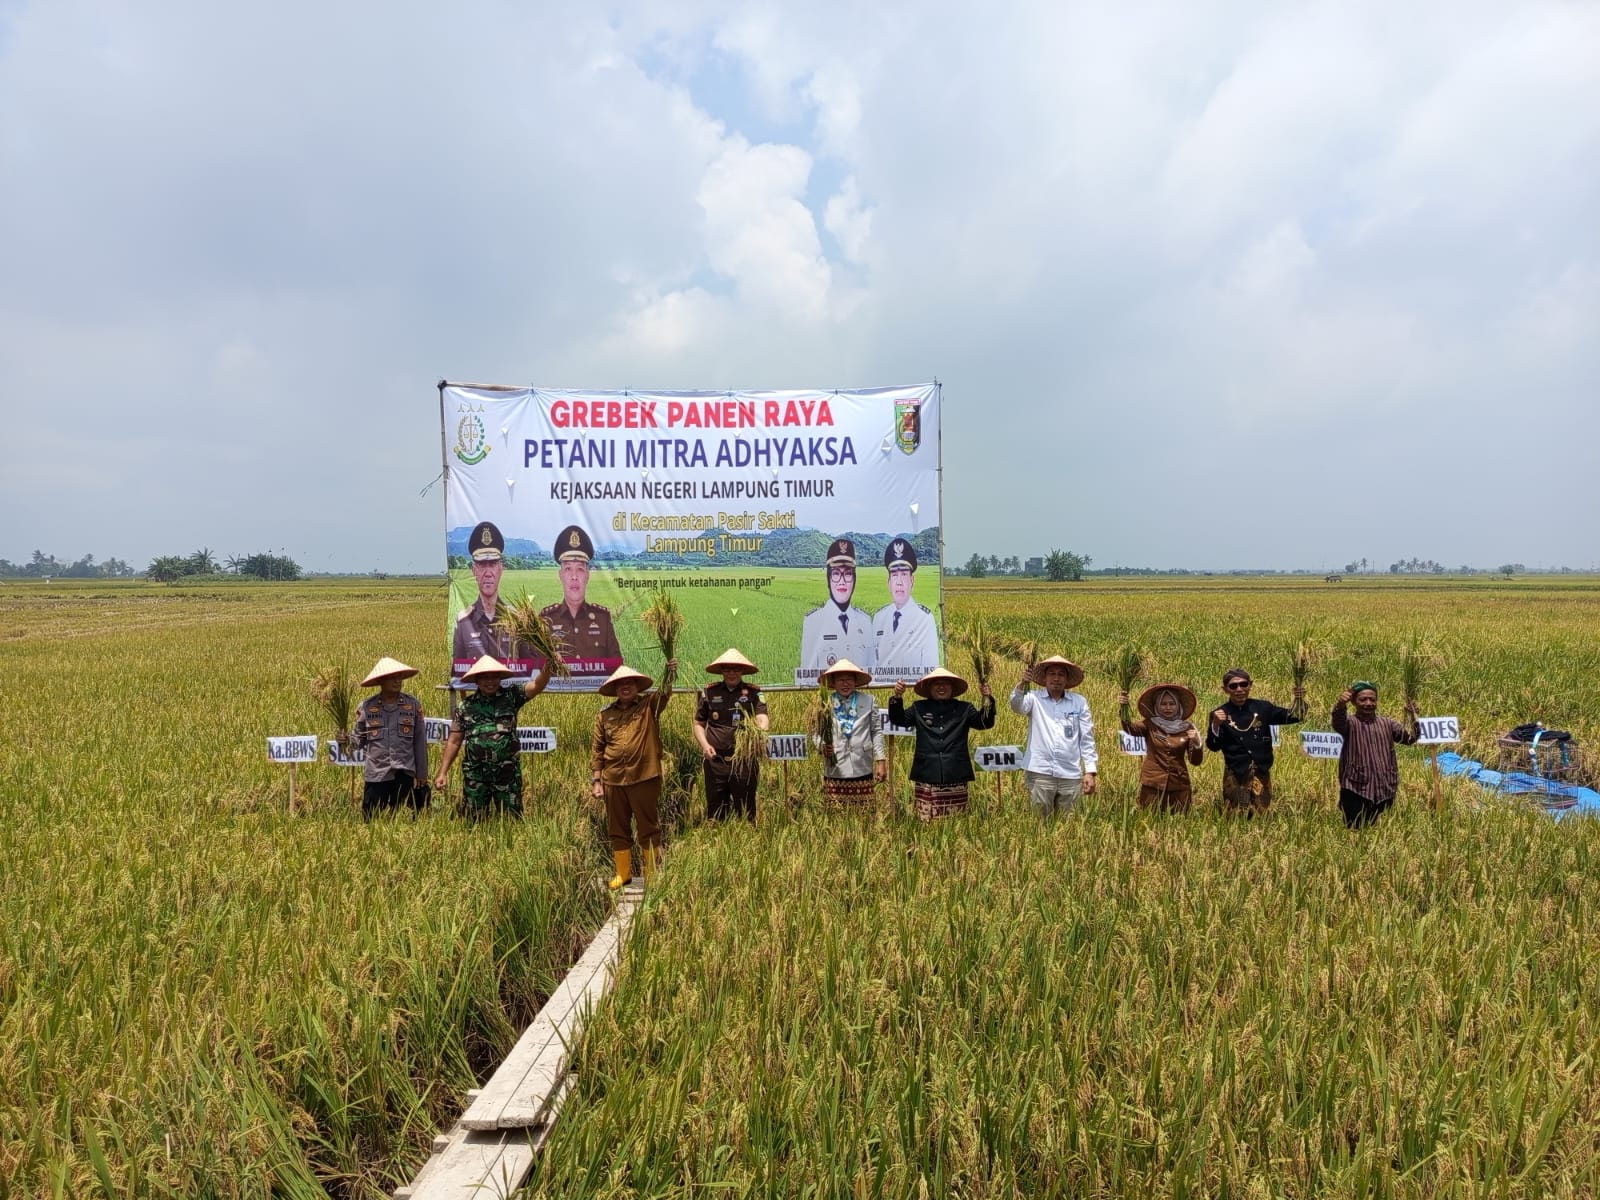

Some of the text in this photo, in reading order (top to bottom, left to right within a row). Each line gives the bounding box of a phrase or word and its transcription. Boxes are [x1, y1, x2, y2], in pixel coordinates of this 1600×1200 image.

[551, 400, 834, 428] GREBEK PANEN RAYA
[524, 437, 857, 468] PETANI MITRA ADHYAKSA
[550, 480, 834, 504] KEJAKSAAN NEGERI LAMPUNG TIMUR
[613, 510, 796, 531] di Kecamatan Pasir Sakti
[647, 535, 763, 558] Lampung Timur
[659, 576, 687, 588] untuk
[689, 576, 737, 588] ketahanan
[874, 666, 895, 676] AZWAR
[517, 730, 547, 739] WAKIL
[268, 741, 315, 759] Ka.BBWS
[519, 742, 549, 751] UPATI
[983, 753, 1016, 765] PLN
